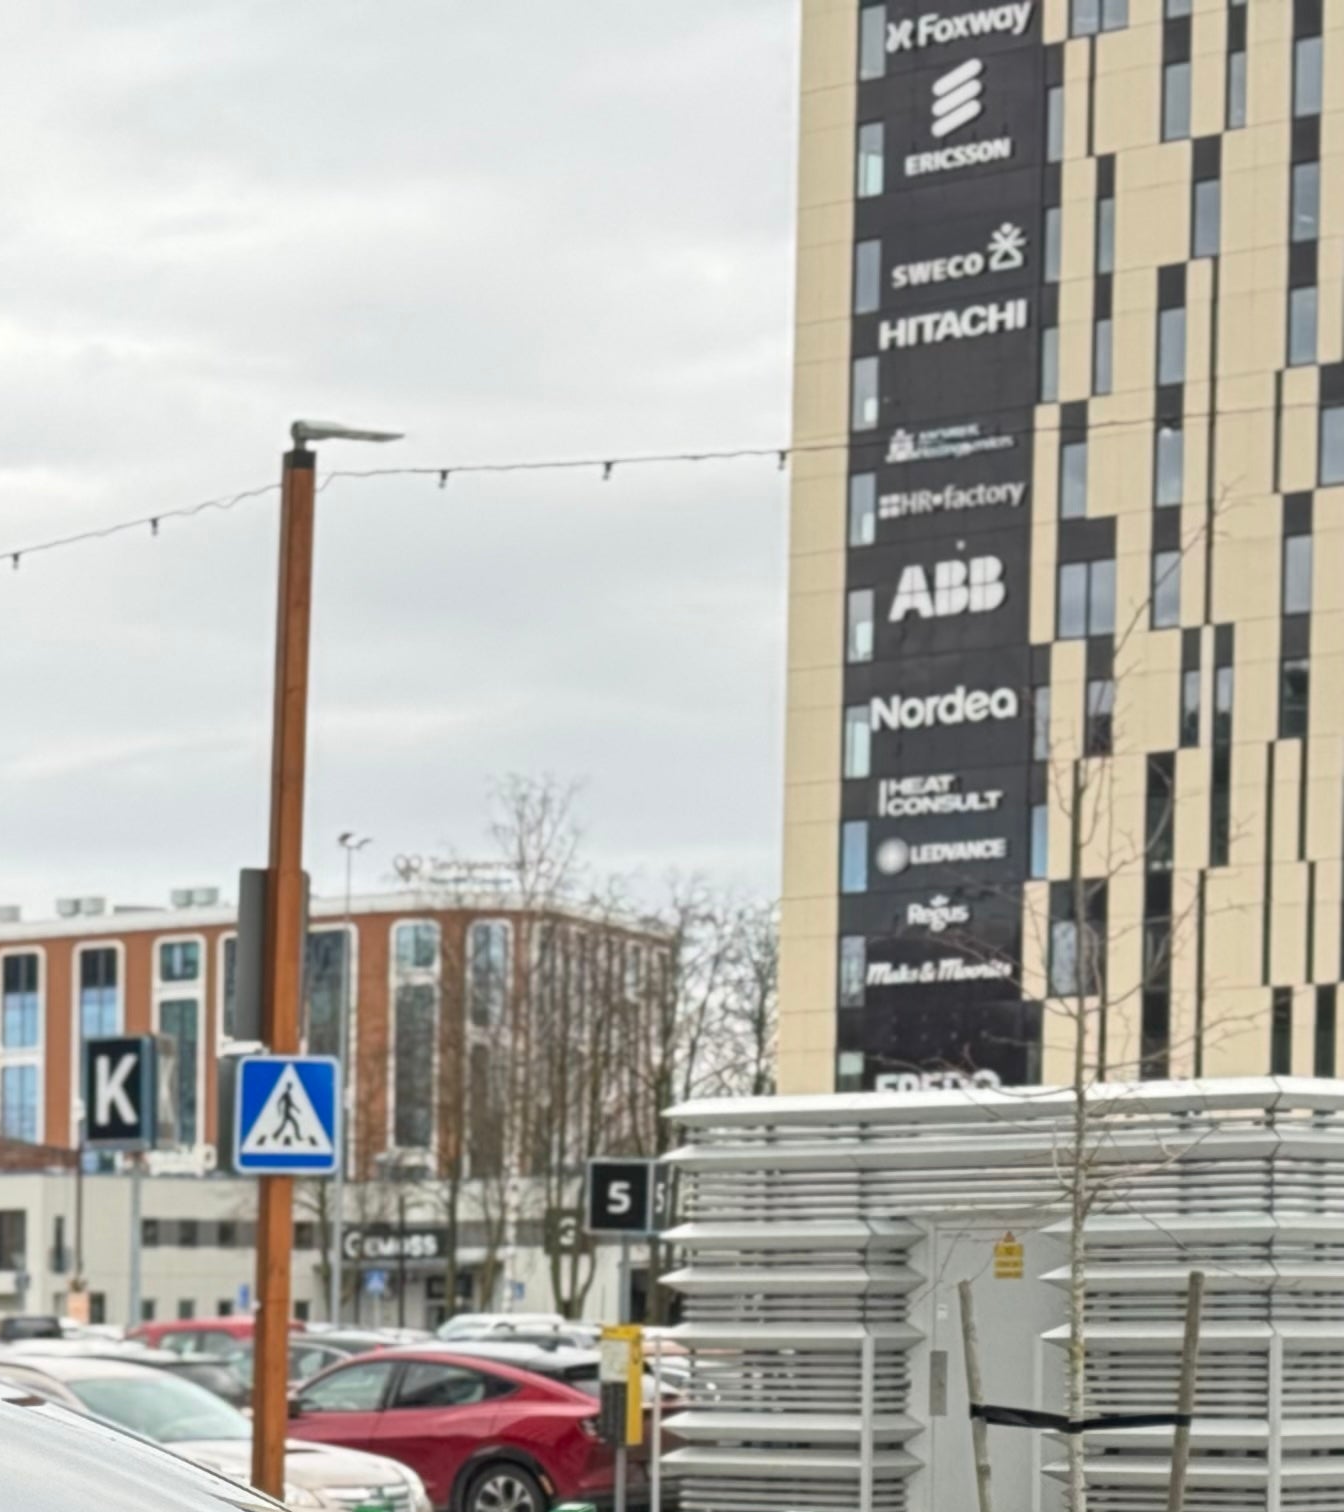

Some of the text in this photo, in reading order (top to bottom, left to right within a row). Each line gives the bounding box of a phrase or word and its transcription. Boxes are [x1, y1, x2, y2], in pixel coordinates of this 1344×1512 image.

[918, 1, 1032, 47] Foxway
[905, 137, 1012, 177] ERICSSON
[892, 252, 985, 289] SWECO
[878, 298, 1028, 351] HITACHI
[889, 555, 1006, 622] ABB
[869, 685, 1018, 732] Nordea
[888, 790, 1004, 816] CONSULT
[889, 774, 955, 796] HEAT
[910, 838, 1007, 864] LEDVANCE
[908, 902, 969, 932] Regus
[96, 1053, 138, 1126] K
[607, 1181, 631, 1214] 5
